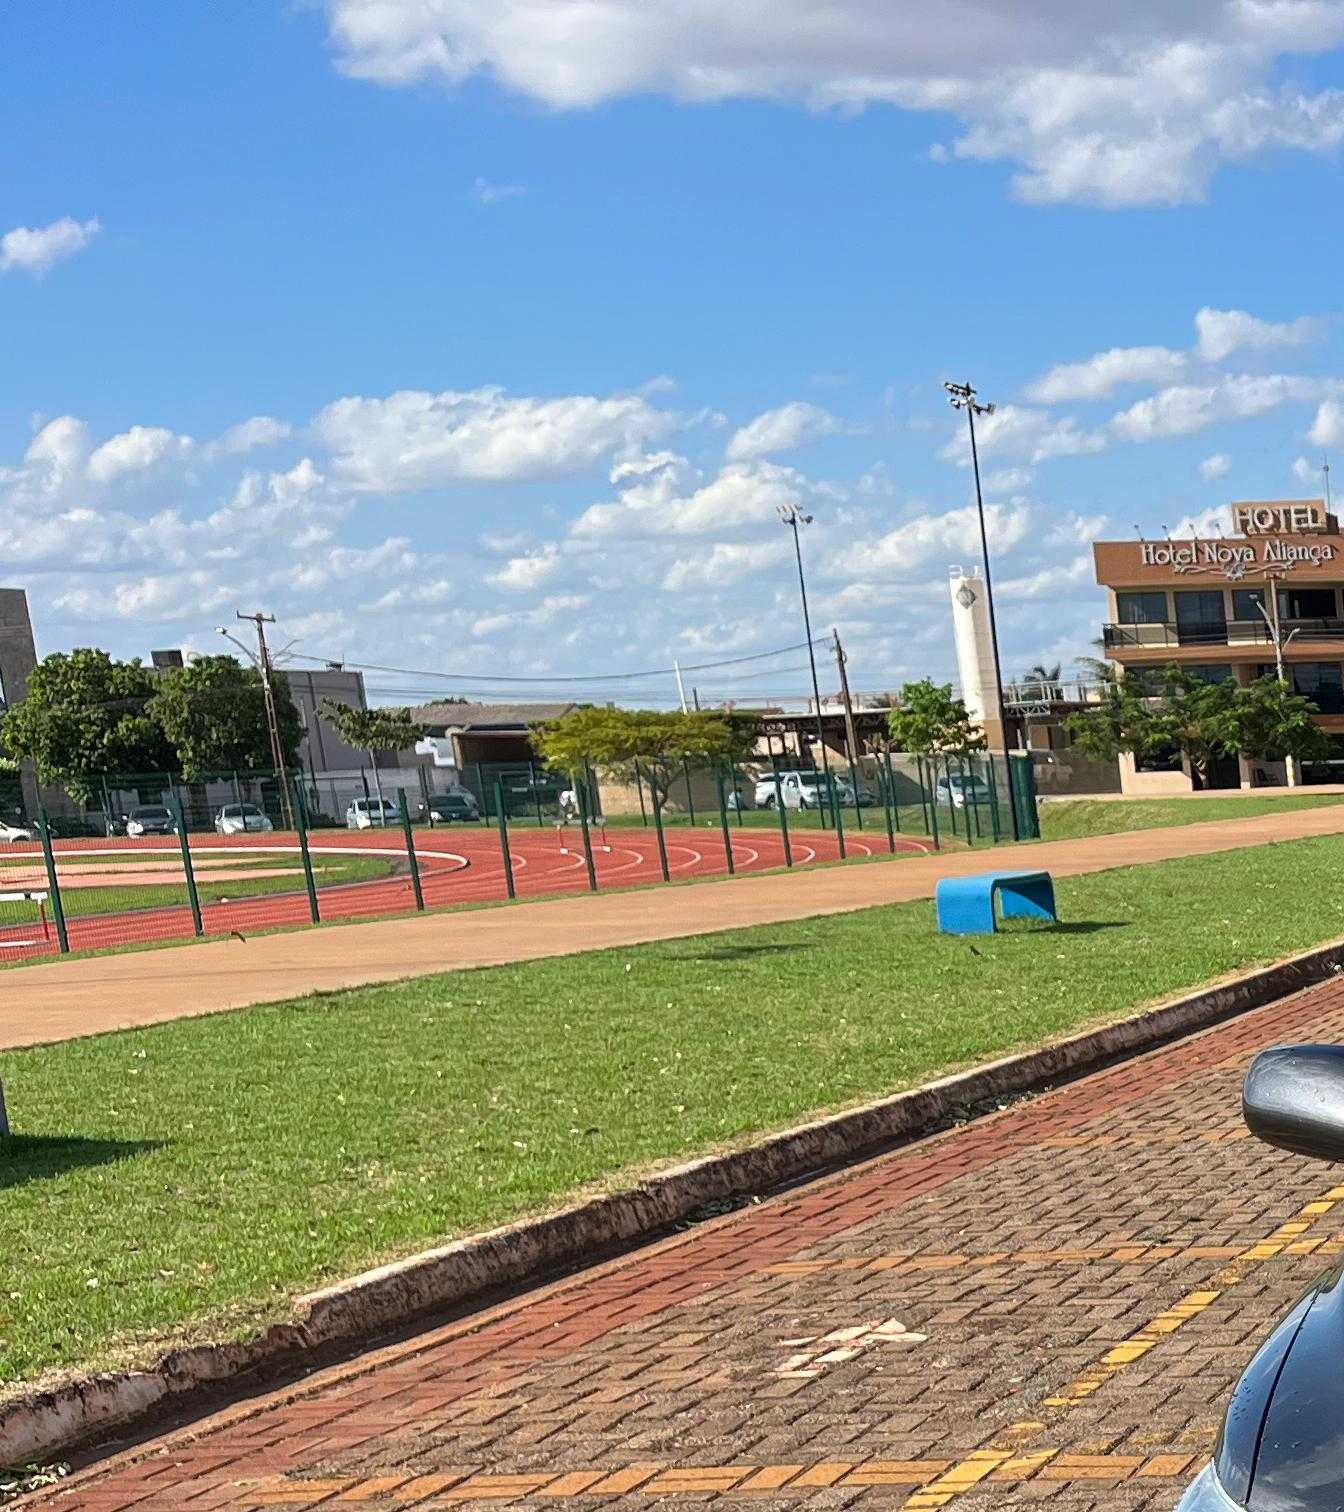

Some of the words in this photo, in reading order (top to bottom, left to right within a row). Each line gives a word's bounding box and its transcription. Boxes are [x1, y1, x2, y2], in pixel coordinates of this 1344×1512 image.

[1234, 505, 1322, 534] HOTEL
[1140, 542, 1198, 566] Hotel
[1203, 542, 1255, 565] Nova
[1263, 539, 1334, 567] Aliança
